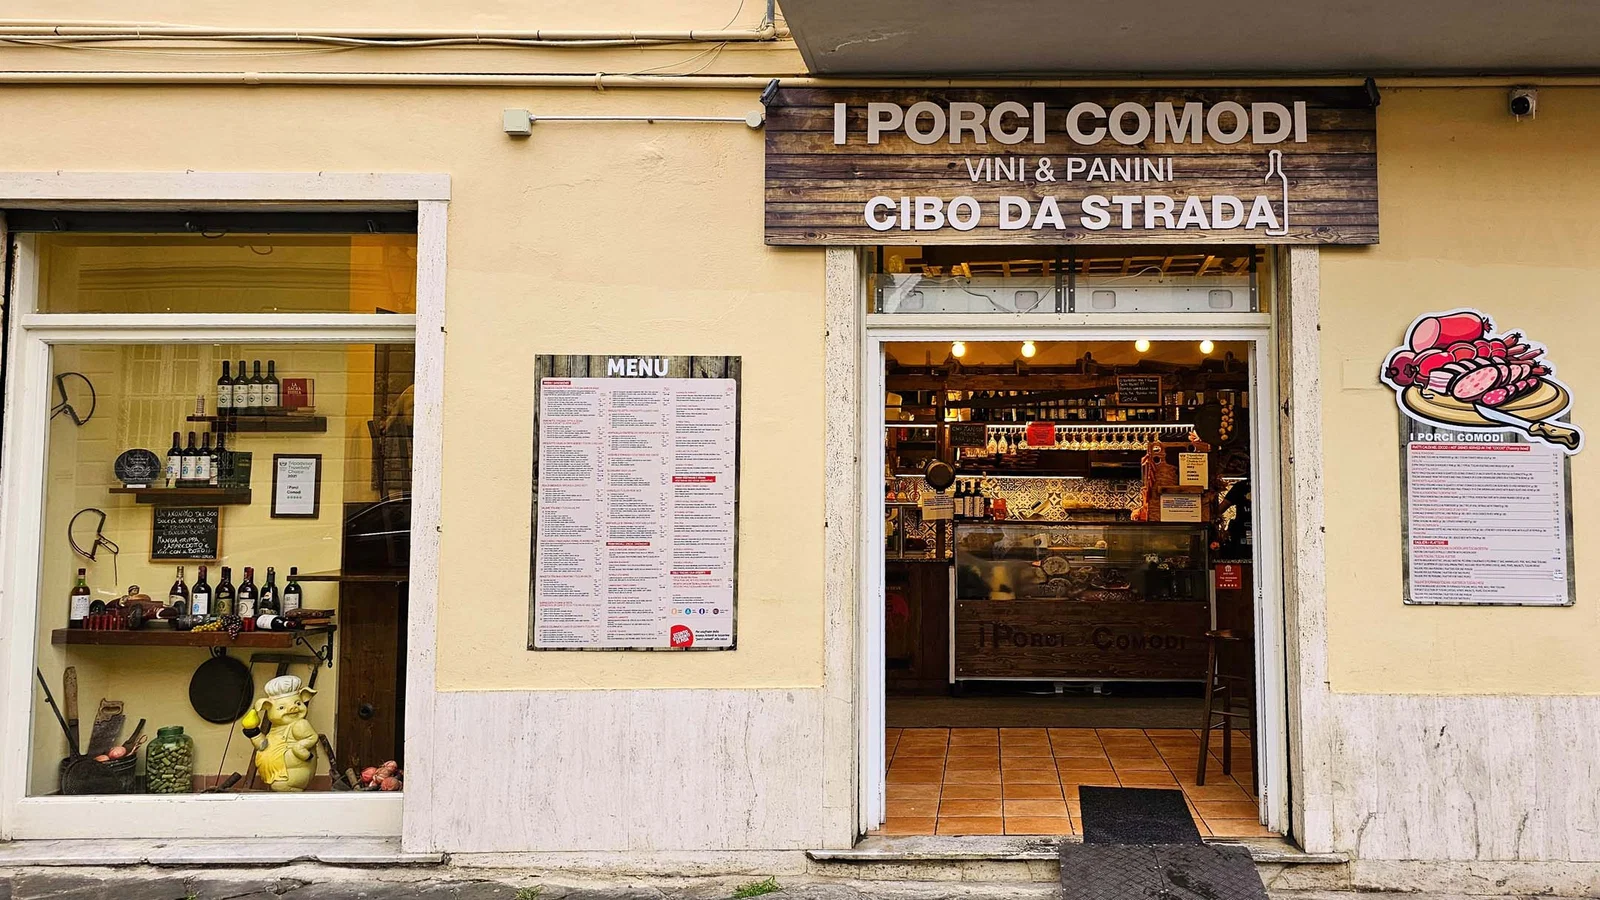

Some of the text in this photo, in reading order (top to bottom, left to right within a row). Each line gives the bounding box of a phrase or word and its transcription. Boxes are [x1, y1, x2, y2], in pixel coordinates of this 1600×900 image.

[833, 100, 1308, 146] I PORCI COMODI
[965, 156, 1173, 183] VINI & PANINI
[864, 193, 1280, 231] CIBO DA STRADA
[607, 358, 669, 377] MENU
[1410, 432, 1504, 443] I PORCI COMODI
